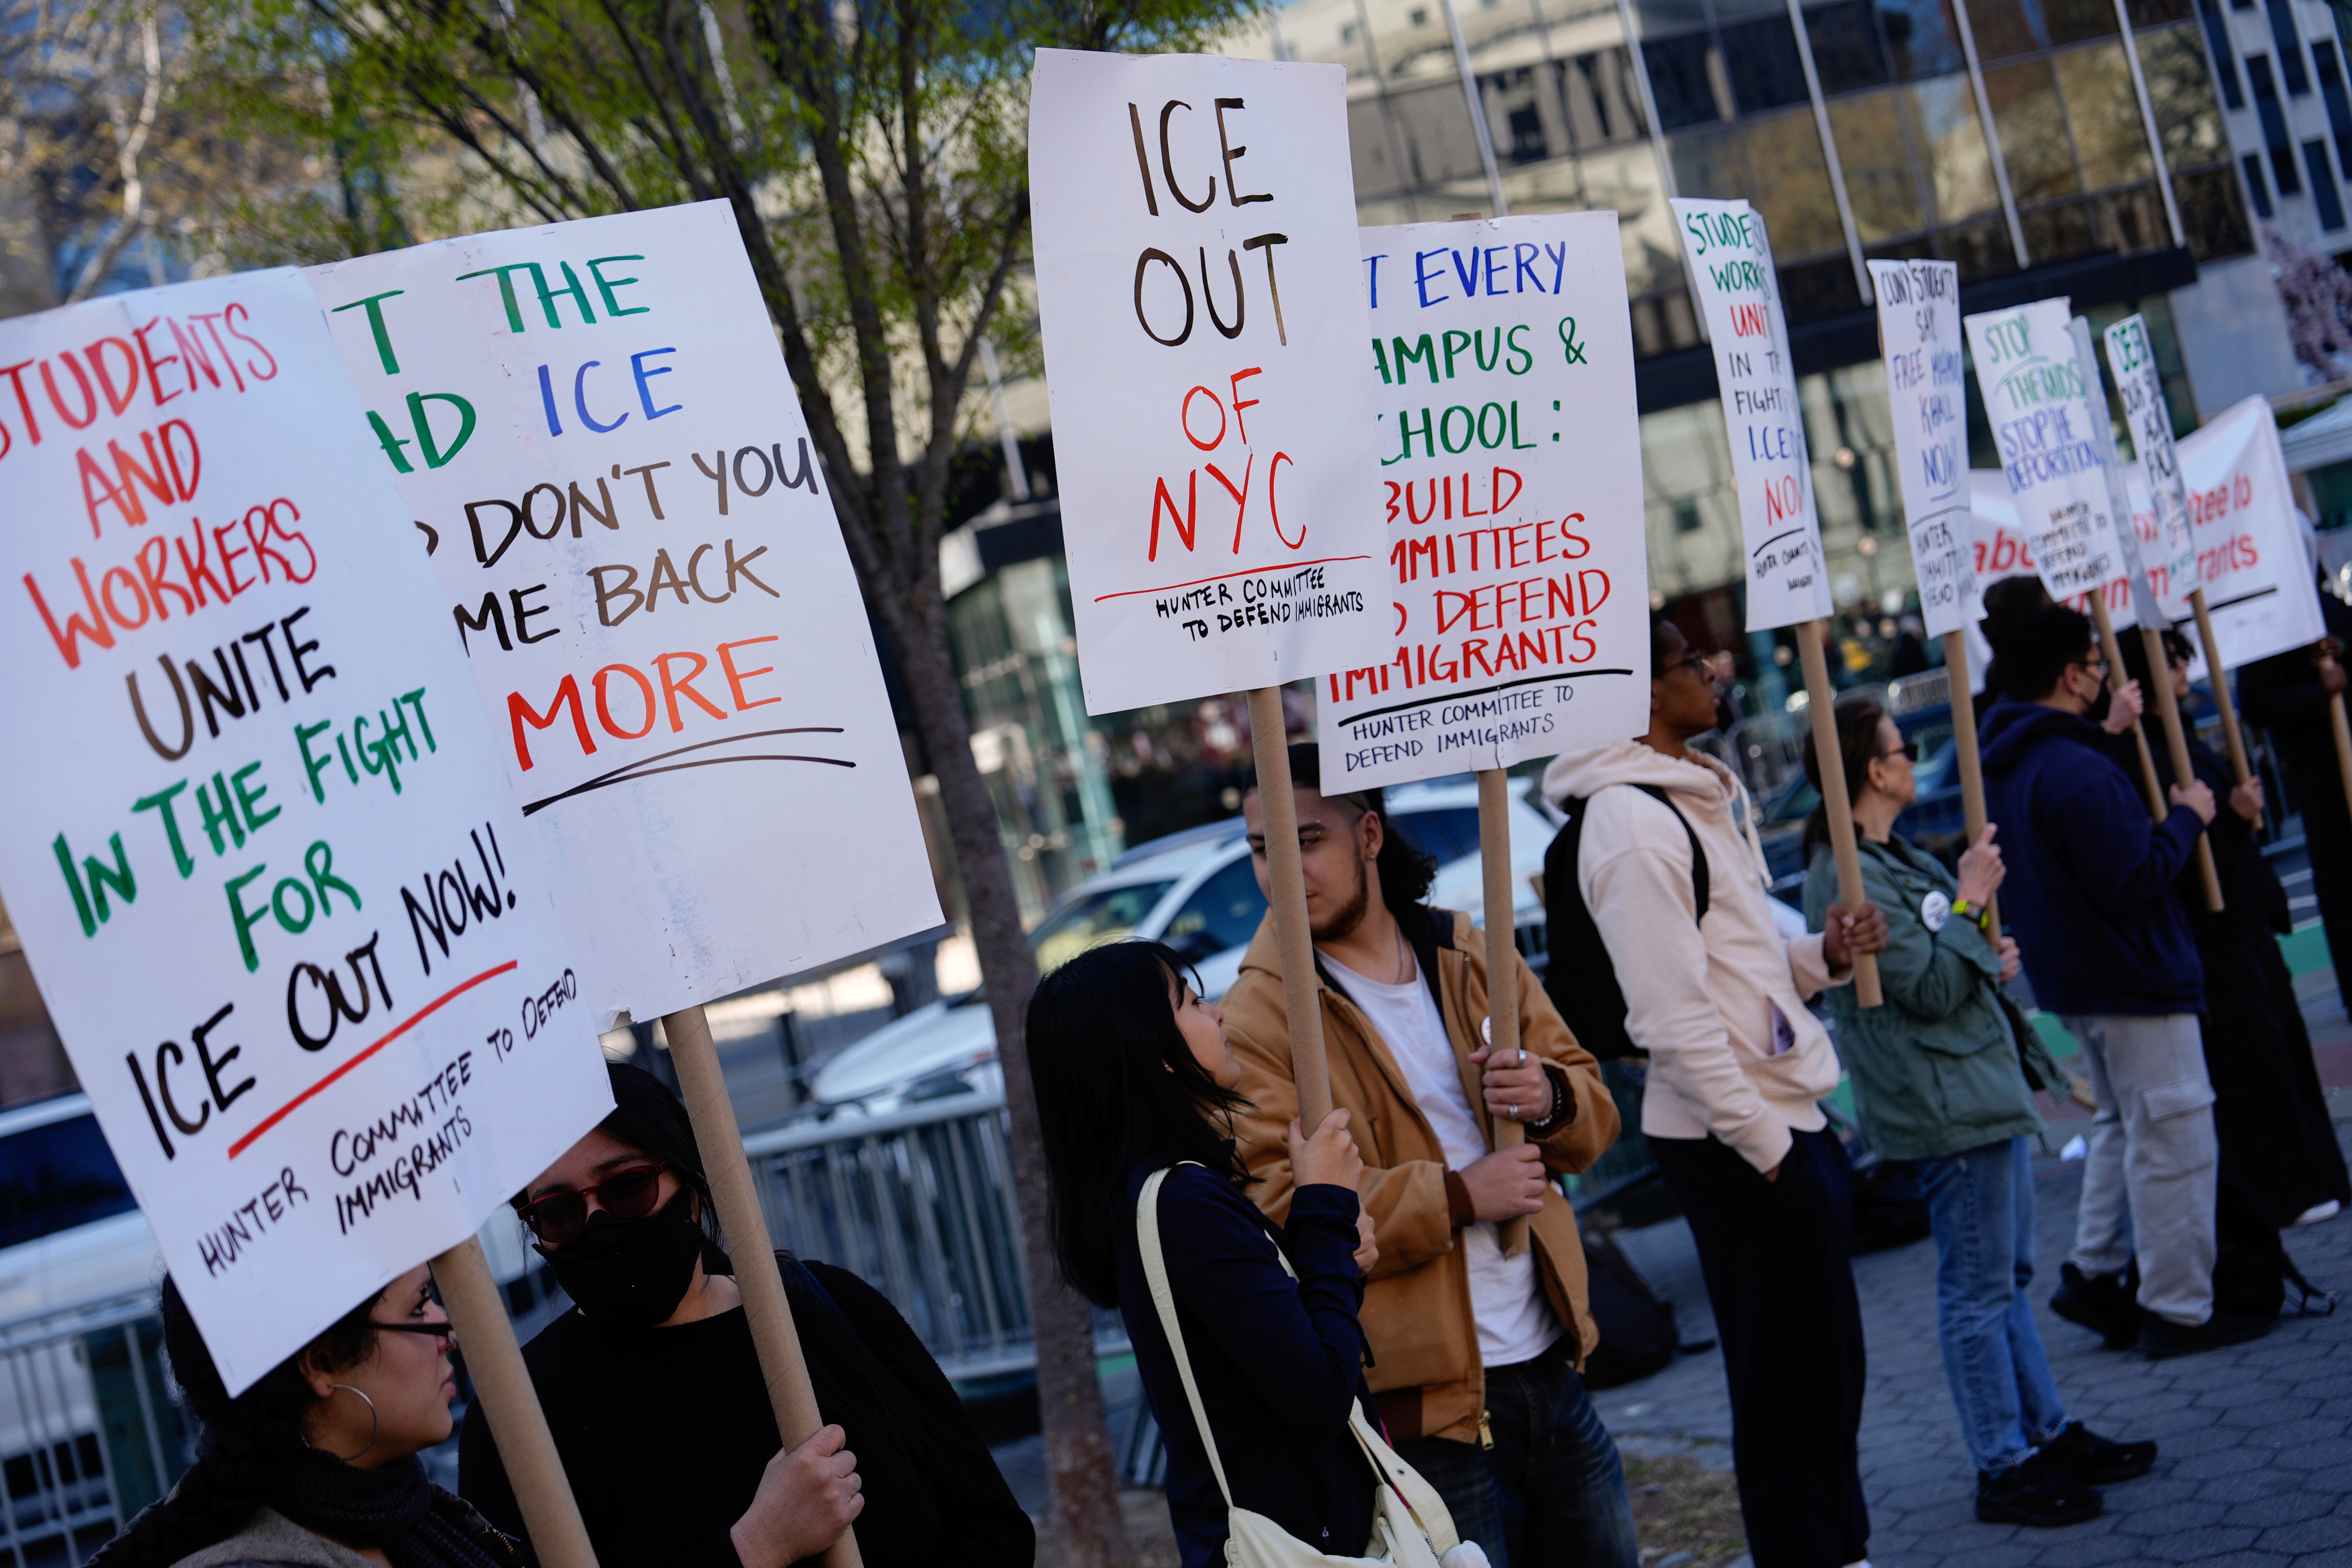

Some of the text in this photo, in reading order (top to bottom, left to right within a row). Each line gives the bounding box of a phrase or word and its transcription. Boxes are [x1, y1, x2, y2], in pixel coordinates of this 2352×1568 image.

[1128, 98, 1273, 216] ICE
[456, 255, 650, 333] THE
[1134, 233, 1288, 347] OUT
[1414, 241, 1565, 308] EVERY
[0, 302, 278, 460] TUDENTS
[1559, 316, 1587, 365] &
[1729, 352, 1752, 378] IN
[1893, 348, 1925, 390] FREE
[1984, 312, 2031, 364] STOP
[537, 347, 683, 437] ICE
[1181, 367, 1262, 450] OF
[1734, 387, 1783, 415] FIGHT
[2000, 408, 2048, 458] STOP
[76, 418, 200, 540] AND
[464, 437, 818, 568] DON'T YOU
[1149, 452, 1306, 562] NYC
[22, 498, 317, 669] WORKERS
[587, 539, 780, 626] BACK
[1156, 566, 1325, 618] HUNTER COMMITTEE
[1183, 619, 1208, 641] TO
[1217, 603, 1290, 632] DEFEND
[1295, 591, 1363, 622] IMMIGRANTS
[1433, 570, 1610, 635] DEFEND
[125, 606, 336, 762] UNITE
[507, 635, 782, 772] MORE
[1329, 619, 1596, 703] IMMIGRANTS
[1346, 713, 1554, 772] DEFEND IMMIGRANTS
[1354, 685, 1573, 740] HUNTER COMMITTEE TO
[52, 687, 436, 937] IN THE FIGHT
[225, 840, 361, 973] FOR
[127, 822, 517, 1160] ICE OUT NOW!
[198, 968, 577, 1279] HUNTER COMMITTEE TO DEFEND
[335, 1105, 472, 1235] IMMIGRANTS
